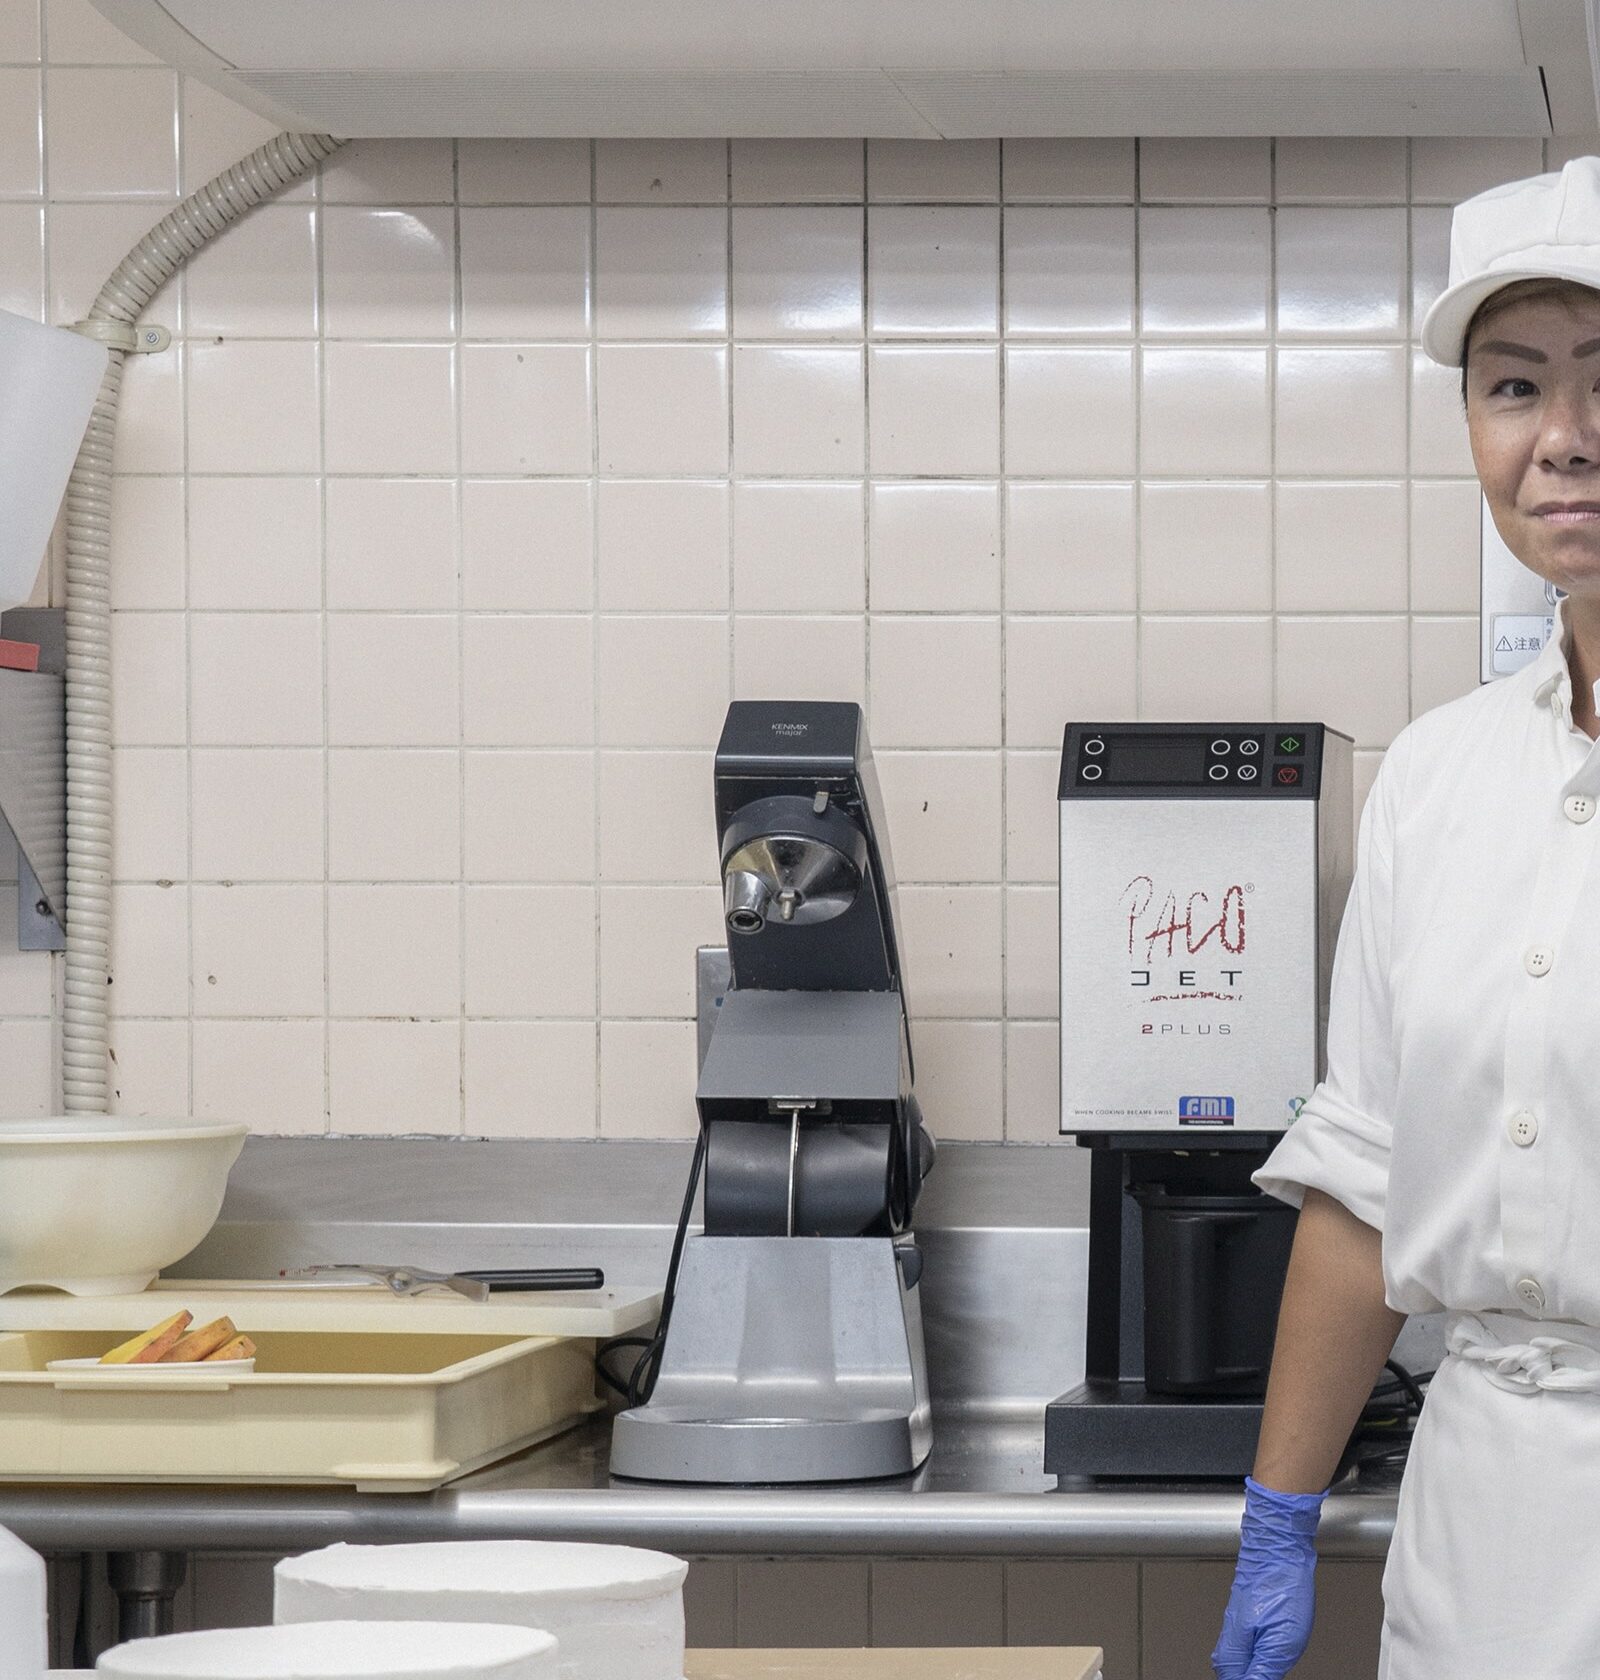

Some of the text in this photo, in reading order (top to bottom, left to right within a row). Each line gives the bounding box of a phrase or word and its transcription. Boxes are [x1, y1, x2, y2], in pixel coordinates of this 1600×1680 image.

[1514, 637, 1541, 651] 注意
[1119, 876, 1245, 963] PACO
[1131, 971, 1243, 986] JET
